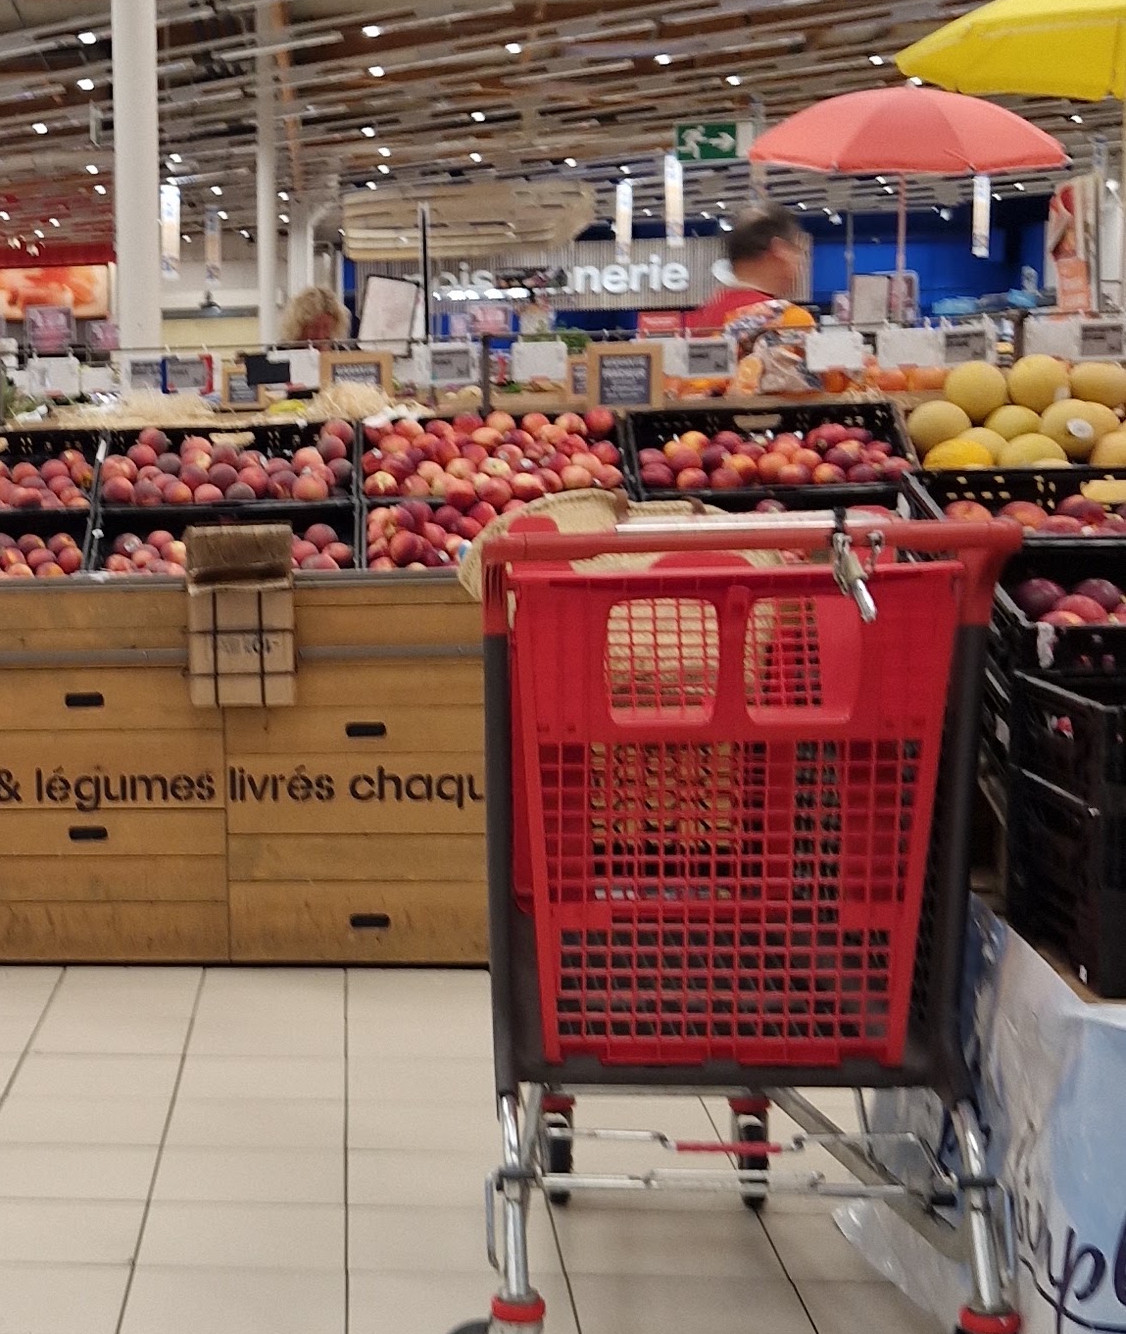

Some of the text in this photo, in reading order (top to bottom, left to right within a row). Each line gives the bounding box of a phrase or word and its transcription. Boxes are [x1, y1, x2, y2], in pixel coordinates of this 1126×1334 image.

[34, 765, 217, 812] légumes
[228, 763, 335, 804] livrés
[348, 766, 486, 808] chaqu
